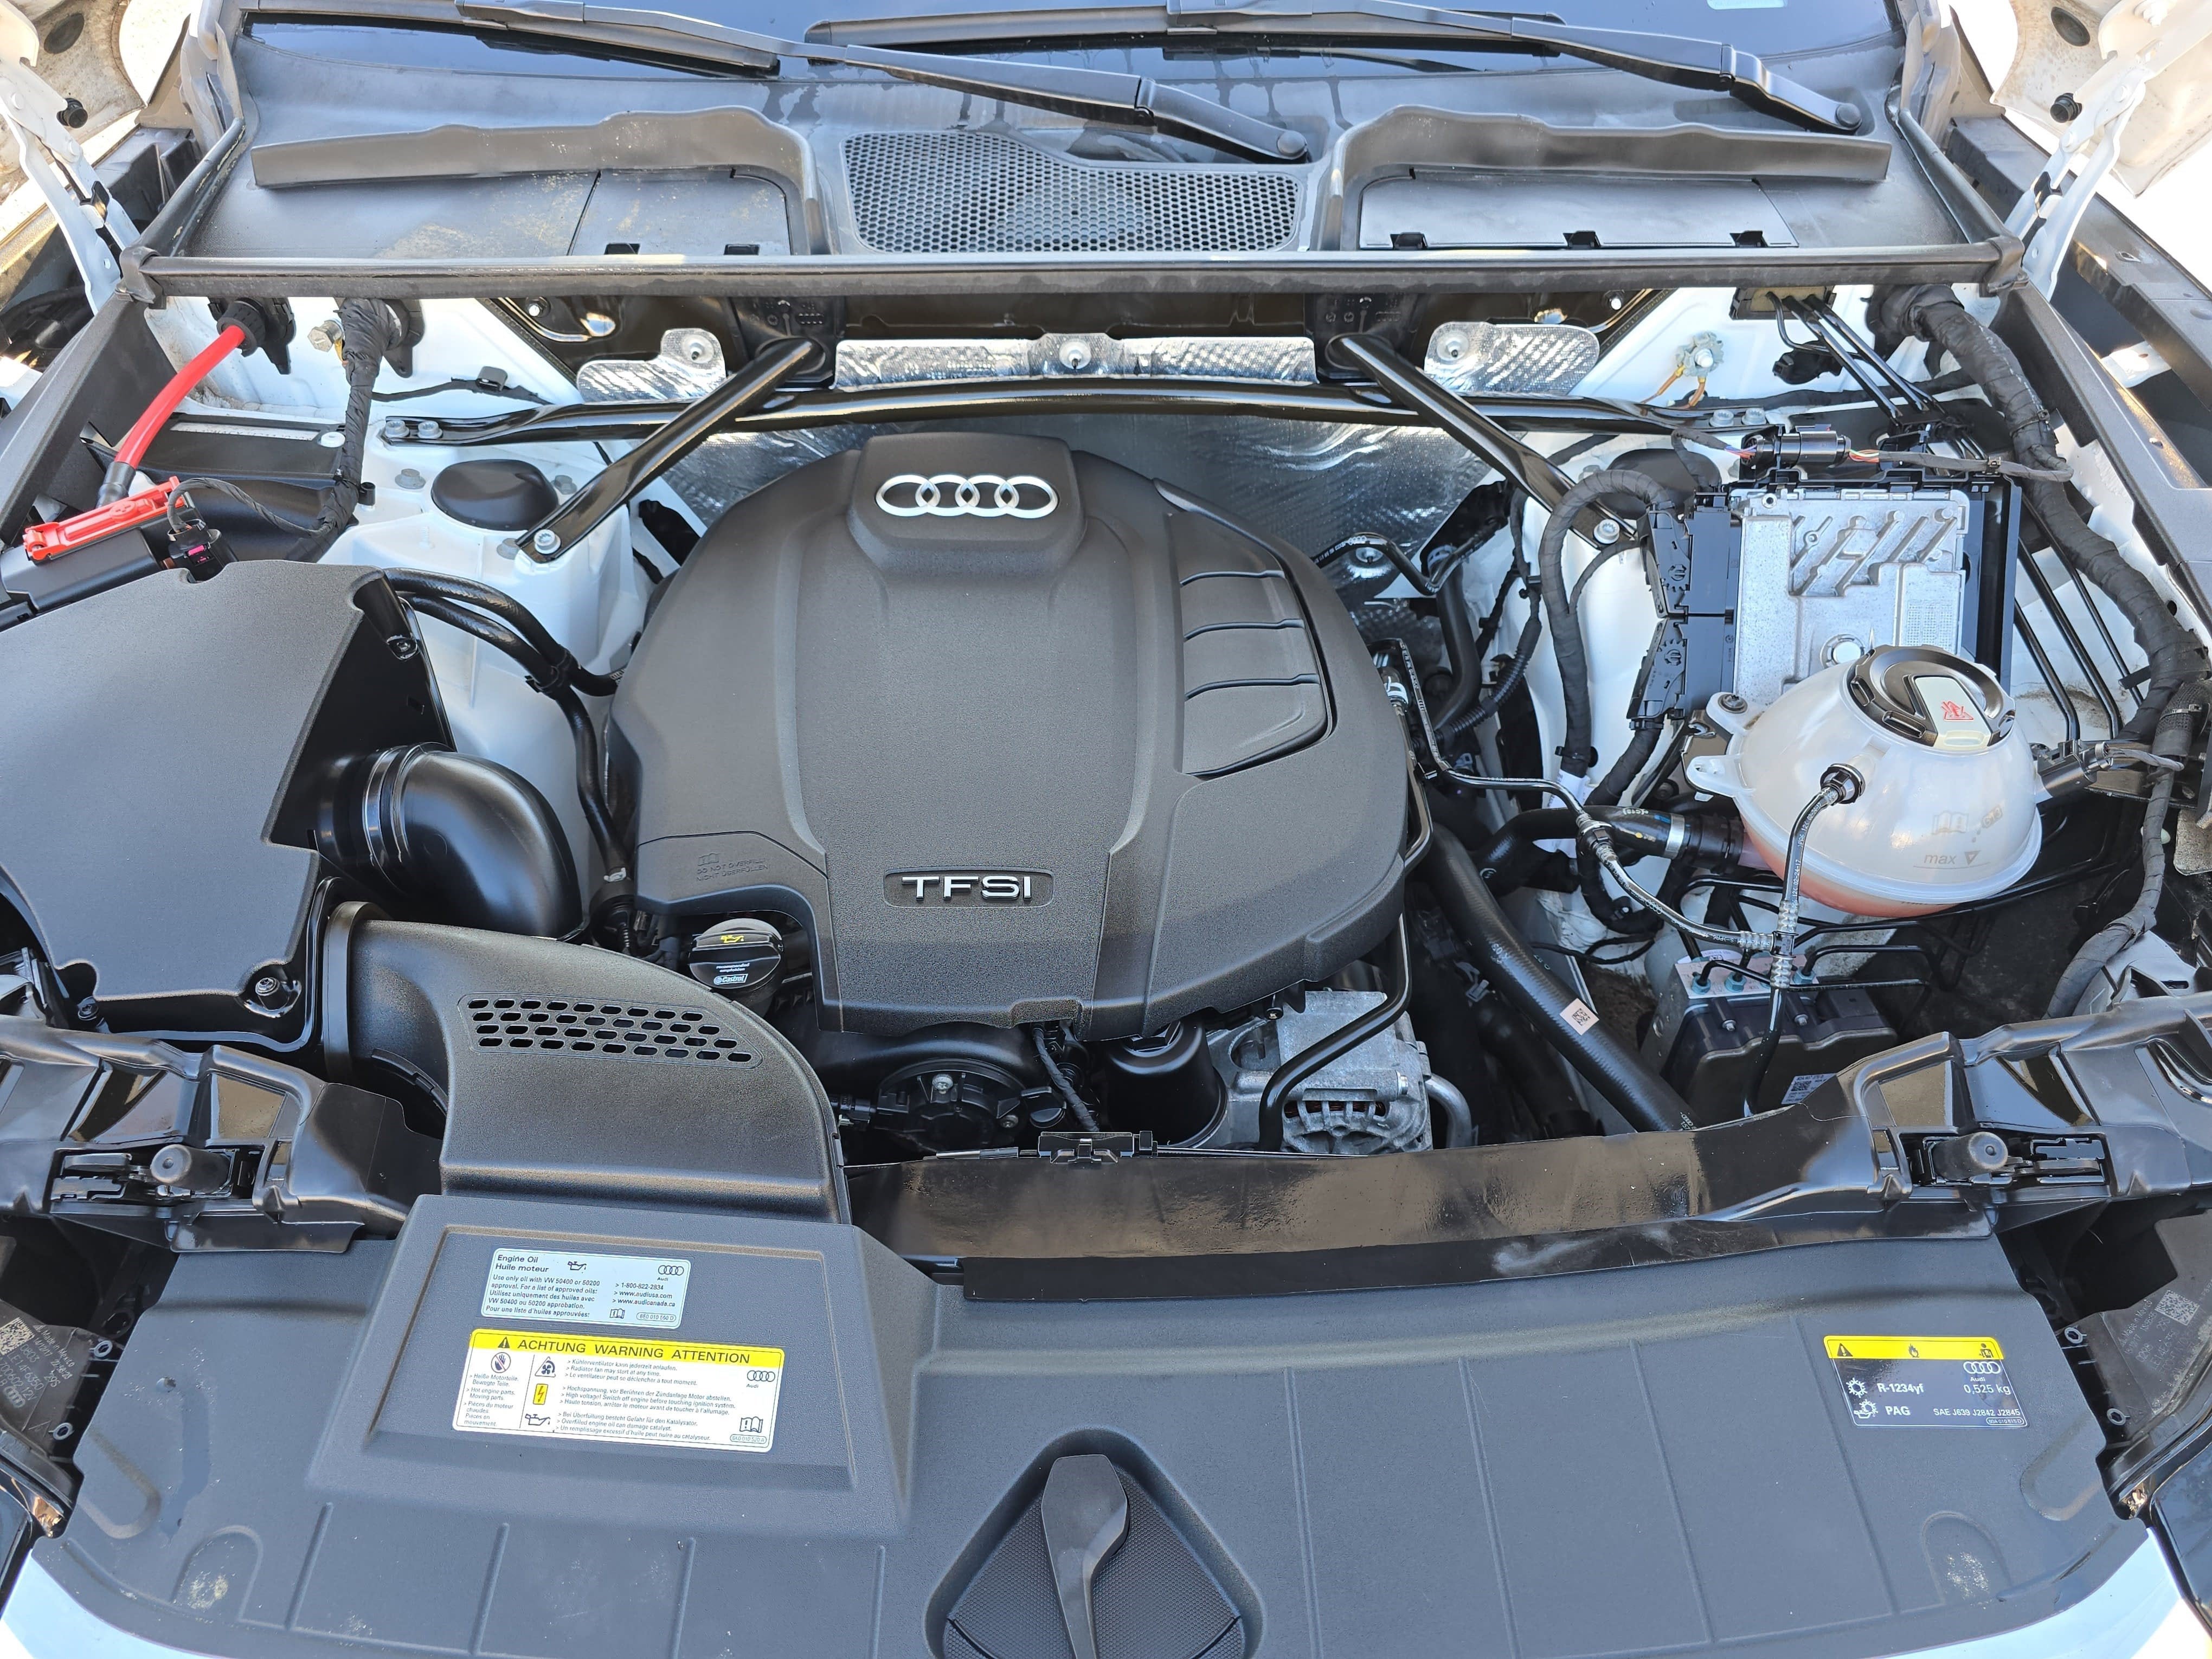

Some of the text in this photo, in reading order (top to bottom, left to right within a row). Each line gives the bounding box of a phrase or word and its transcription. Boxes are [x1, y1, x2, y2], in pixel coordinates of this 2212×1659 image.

[1924, 853, 1957, 865] max
[902, 876, 1032, 900] TFSI
[722, 975, 745, 983] Castrol
[497, 1255, 524, 1263] Engine
[42, 1330, 56, 1345] Made
[58, 1348, 75, 1367] Mexico
[517, 1340, 749, 1363] ACHTUNG WARNING ATTENTION
[1877, 1383, 1924, 1394] R-1234yf
[1963, 1384, 2011, 1395] 0,525 kg
[1885, 1406, 1911, 1415] PAG
